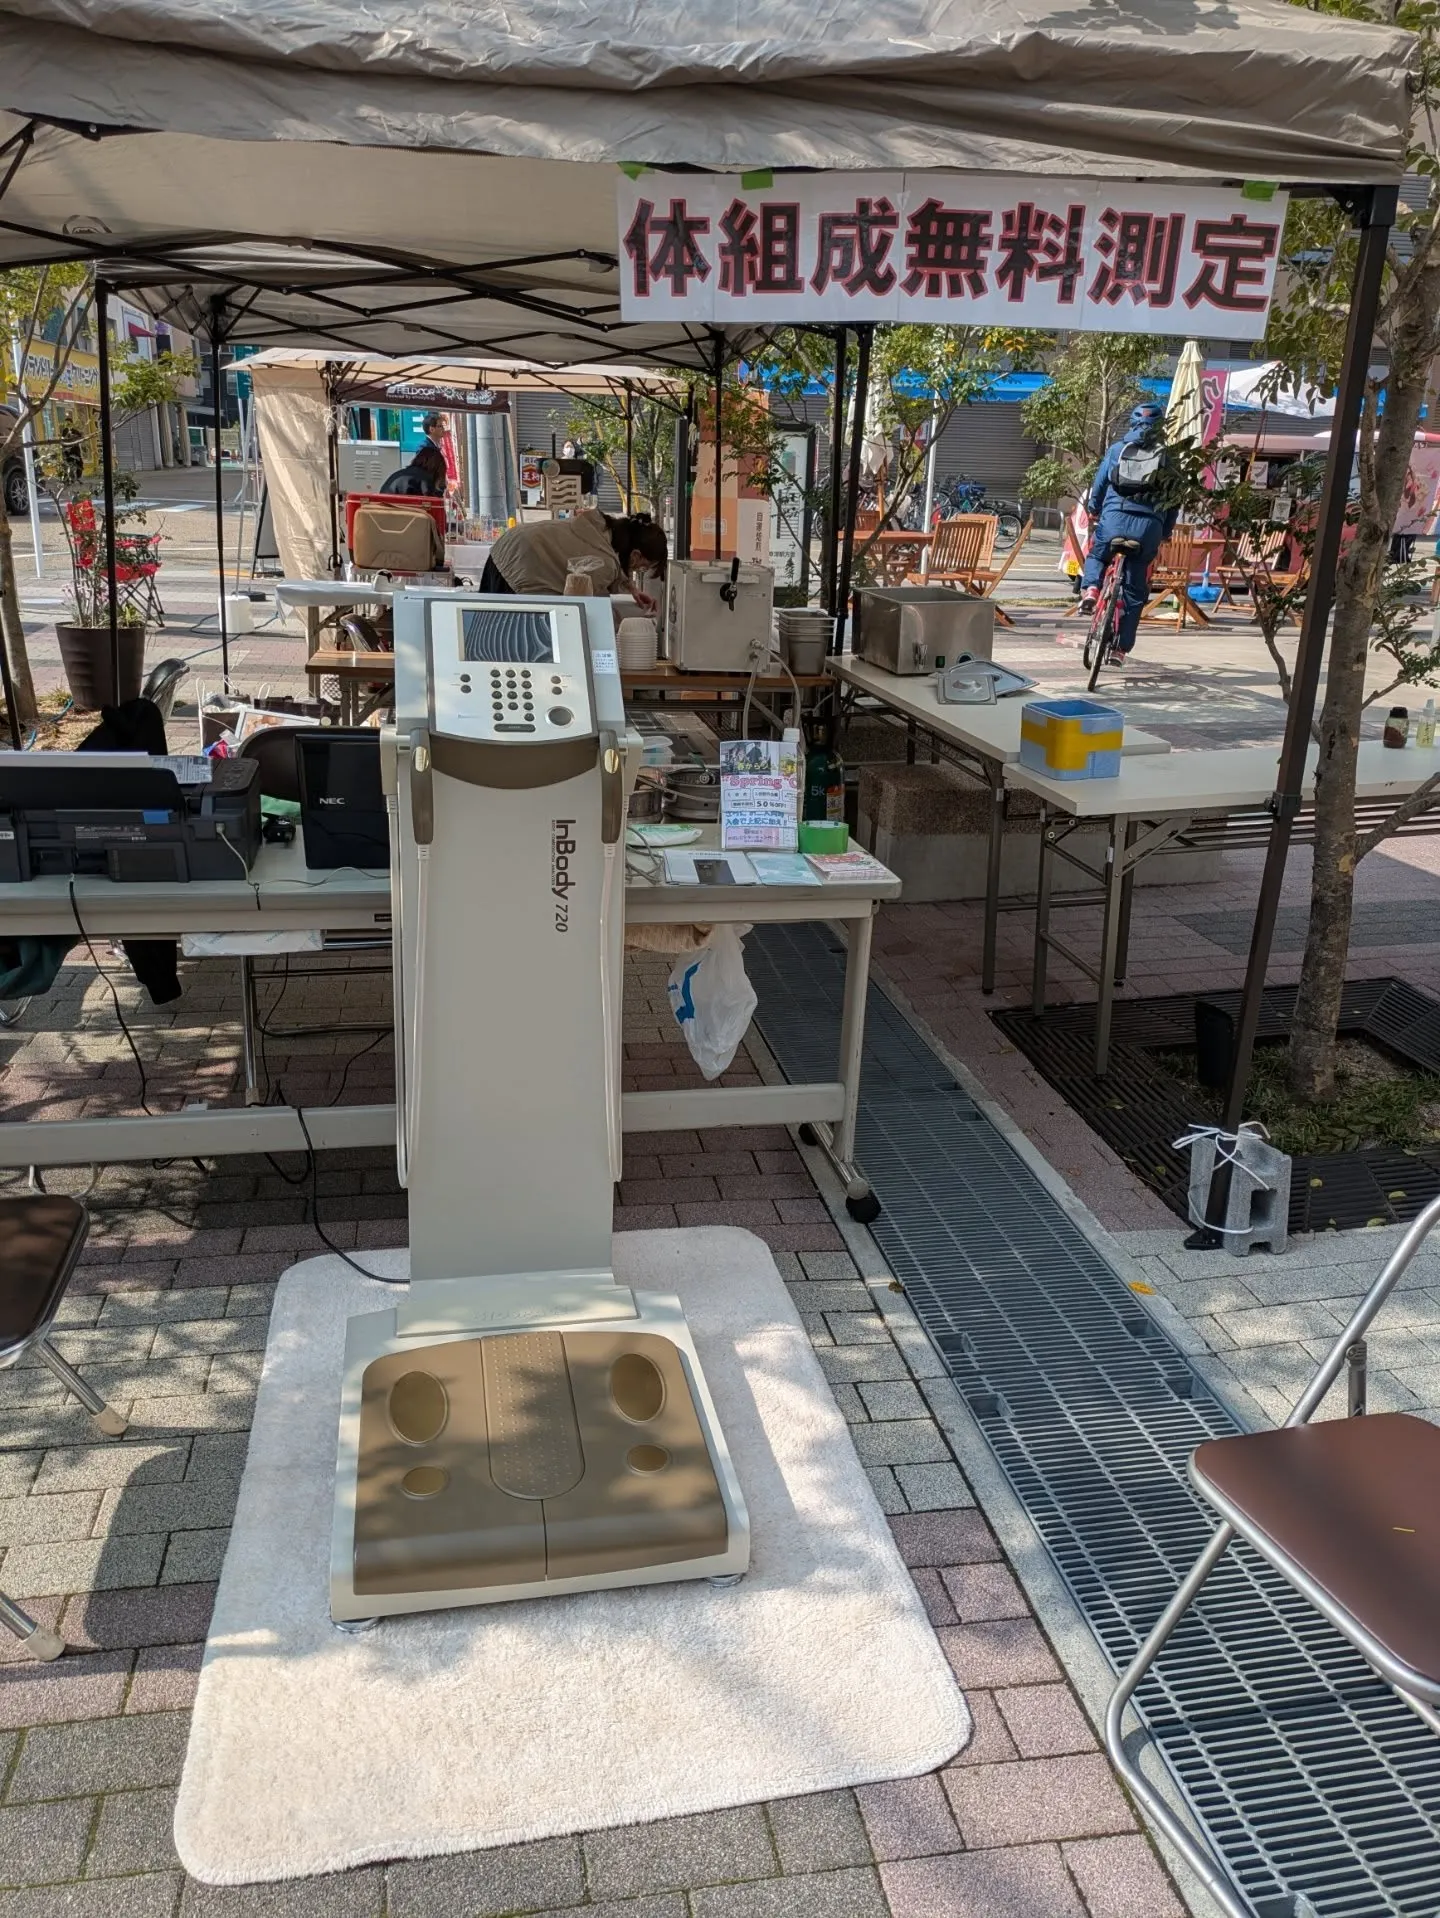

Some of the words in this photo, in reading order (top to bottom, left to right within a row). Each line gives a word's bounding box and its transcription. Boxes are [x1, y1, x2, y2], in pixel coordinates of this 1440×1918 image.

[622, 197, 1280, 313] 体組成無料測定
[319, 797, 345, 805] NEC
[551, 819, 577, 901] InBody
[555, 904, 569, 933] 720
